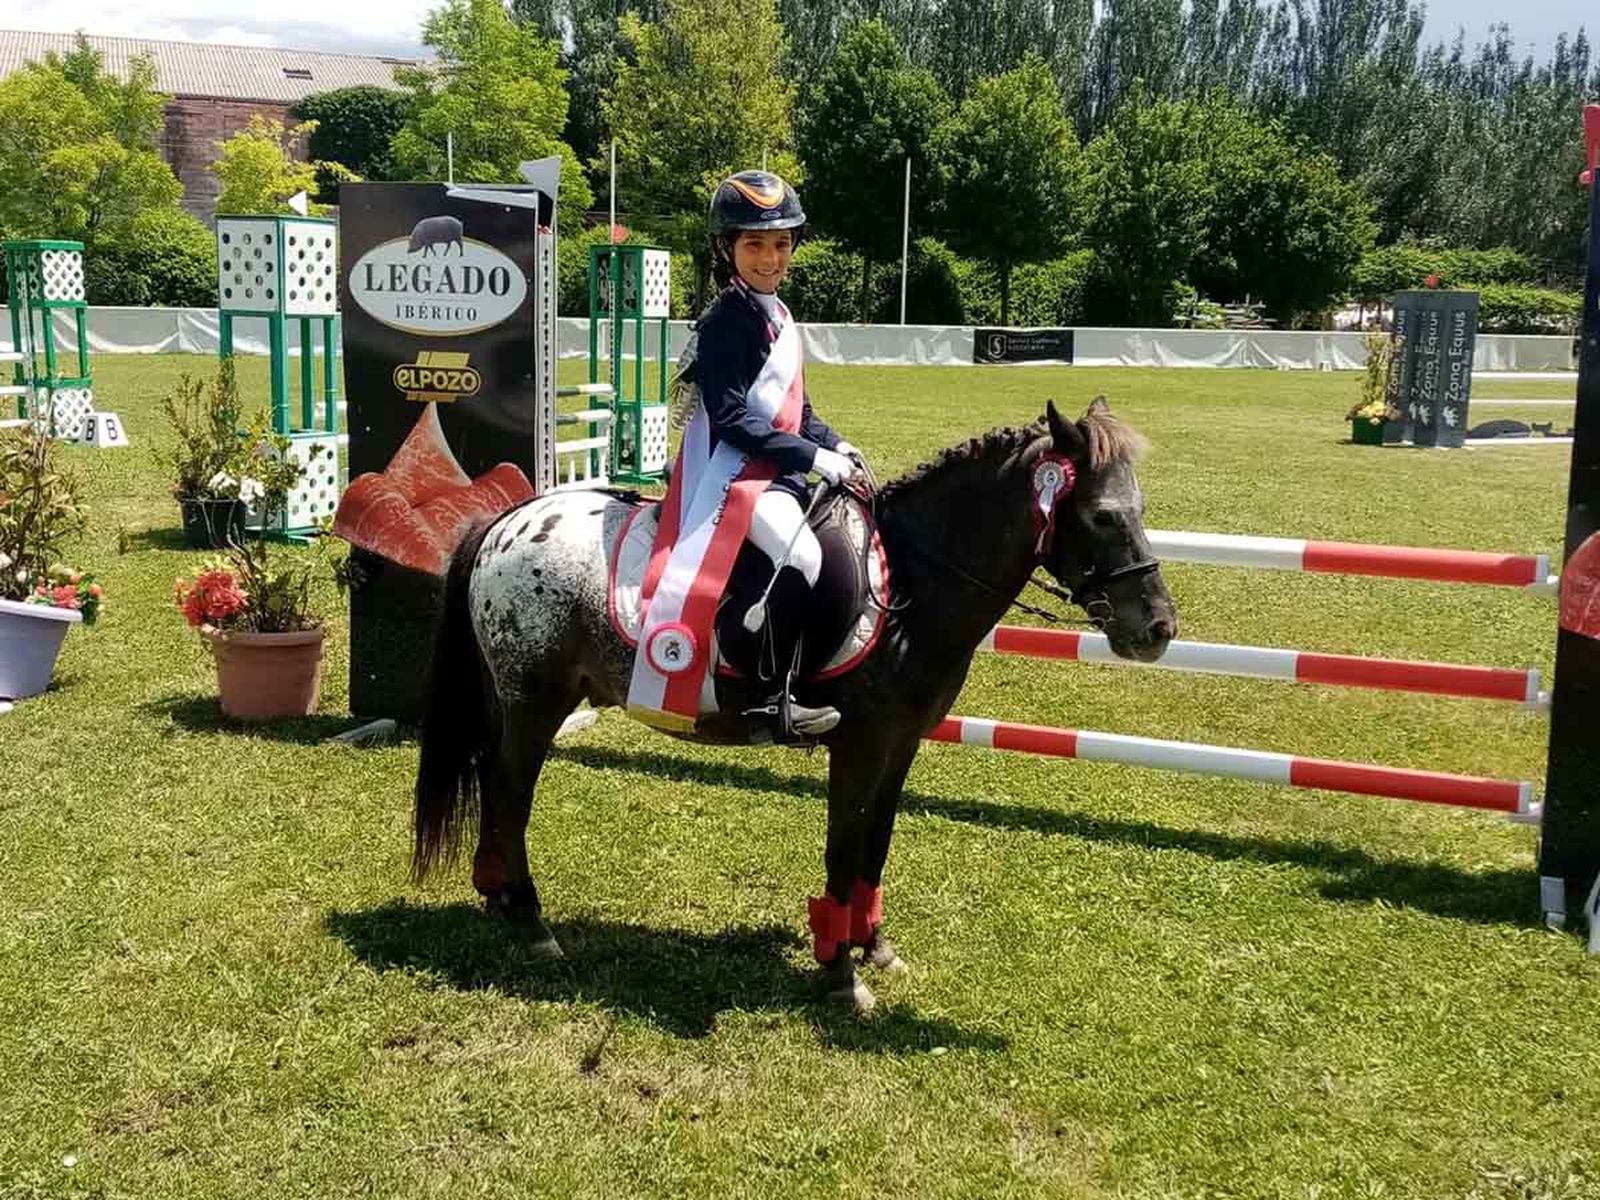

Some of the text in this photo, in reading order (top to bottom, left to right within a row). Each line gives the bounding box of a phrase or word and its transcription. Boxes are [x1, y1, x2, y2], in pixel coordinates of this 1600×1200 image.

[364, 263, 511, 296] LEGADO
[395, 302, 478, 320] IBÉRICO
[1449, 311, 1466, 356] Equus
[1444, 362, 1461, 402] Zona
